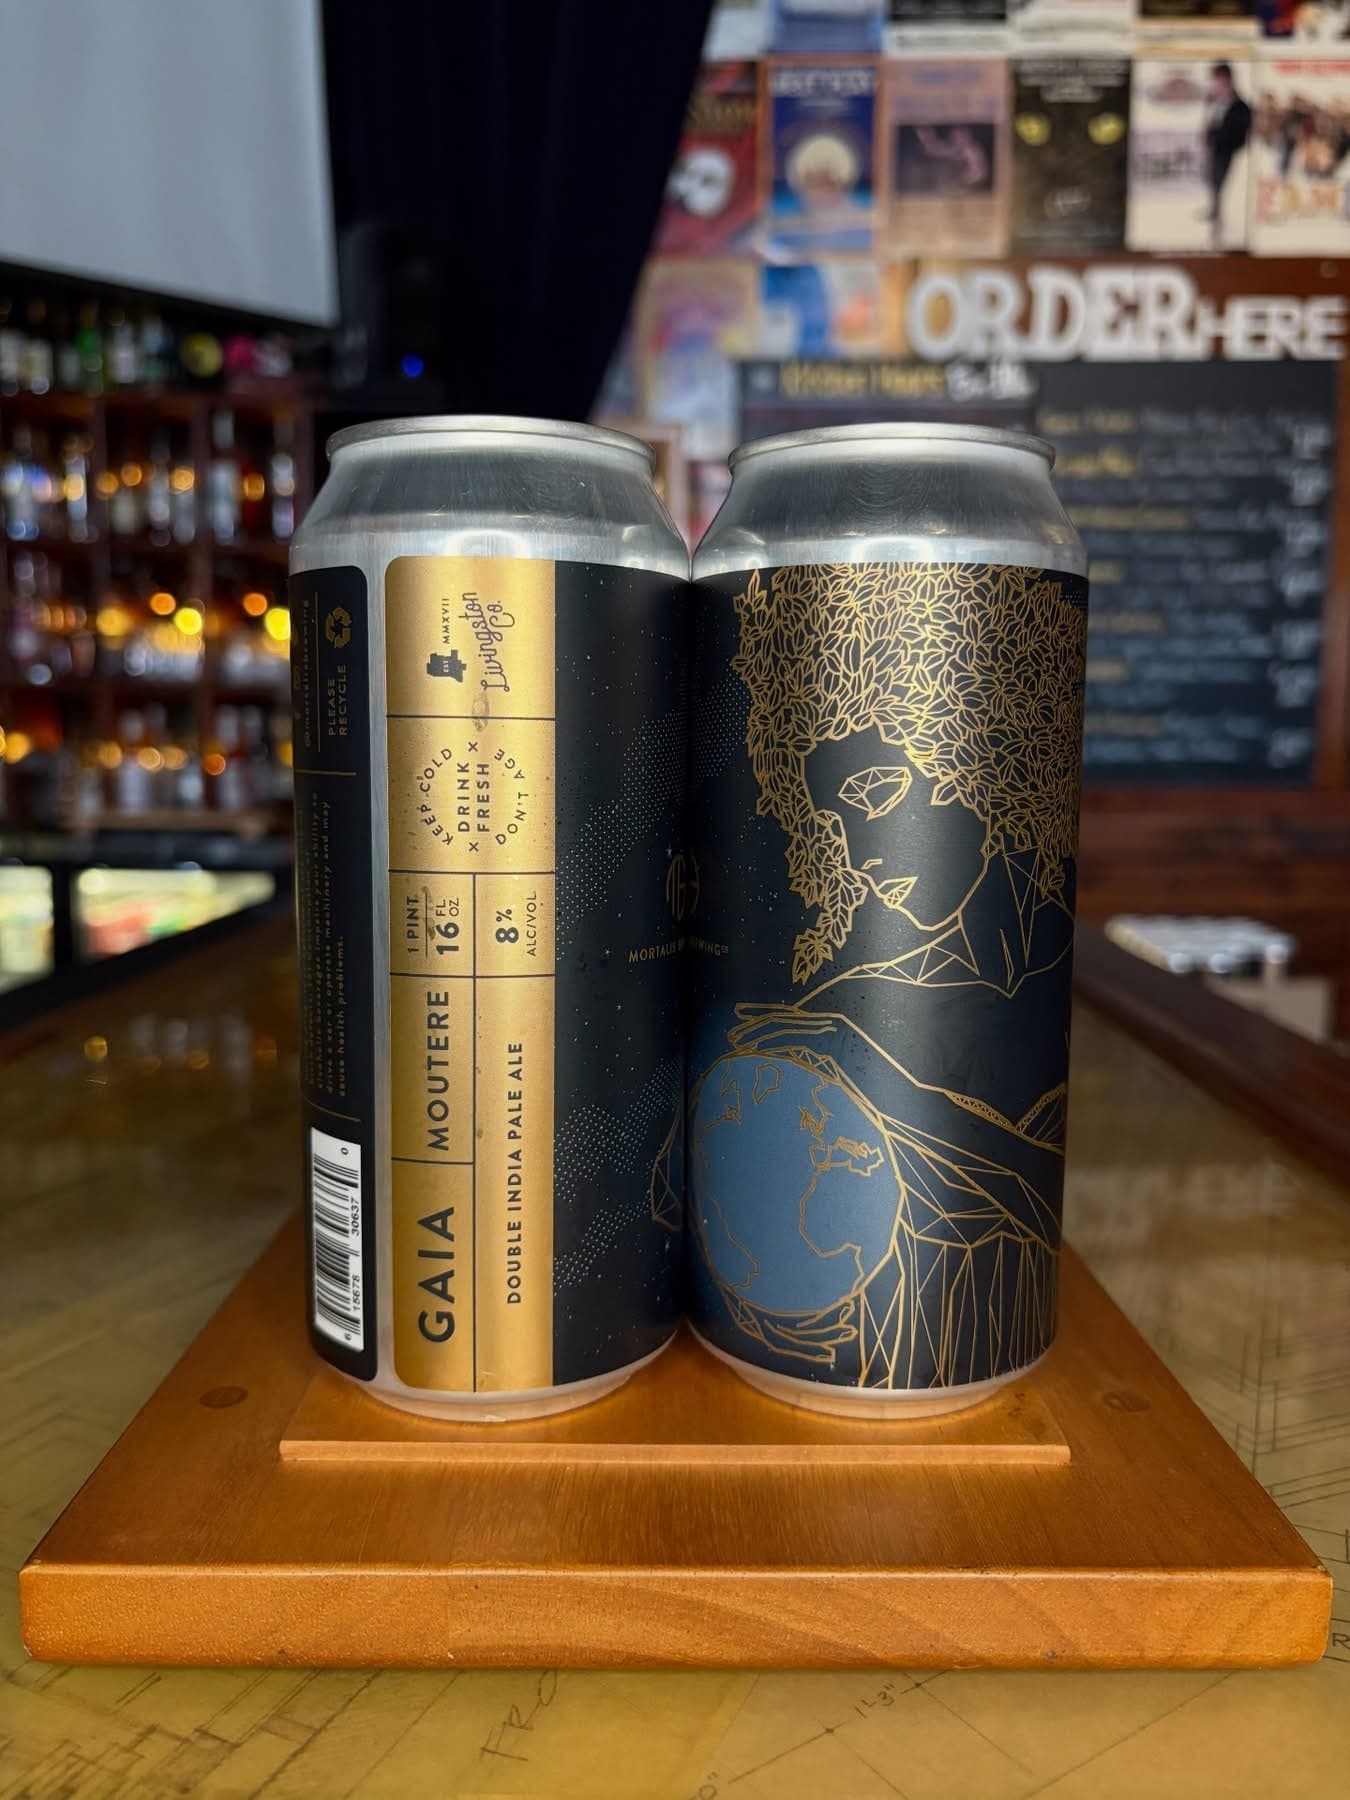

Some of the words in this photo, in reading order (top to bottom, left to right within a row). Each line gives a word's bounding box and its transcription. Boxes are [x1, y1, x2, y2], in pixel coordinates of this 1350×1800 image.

[906, 265, 1211, 362] ORDER
[1200, 296, 1346, 361] HERE
[441, 598, 450, 645] MMXVII
[457, 592, 510, 692] Livingston
[328, 678, 336, 736] PLEASE
[337, 663, 347, 736] RECYCLE
[419, 748, 452, 793] COLD
[494, 748, 525, 779] AGE
[419, 803, 454, 846] KEEP
[457, 762, 470, 833] DRINK
[477, 763, 490, 833] FRESH
[494, 791, 529, 845] DON'T
[407, 895, 419, 940] PINT
[435, 922, 460, 955] 16
[426, 991, 450, 1151] MOUTERE
[507, 1043, 523, 1081] ALE
[507, 1090, 523, 1140] PALE
[507, 1149, 523, 1212] INDIA
[351, 1197, 360, 1236] 30637
[416, 1206, 456, 1343] GAIA
[506, 1220, 523, 1305] DOUBLE
